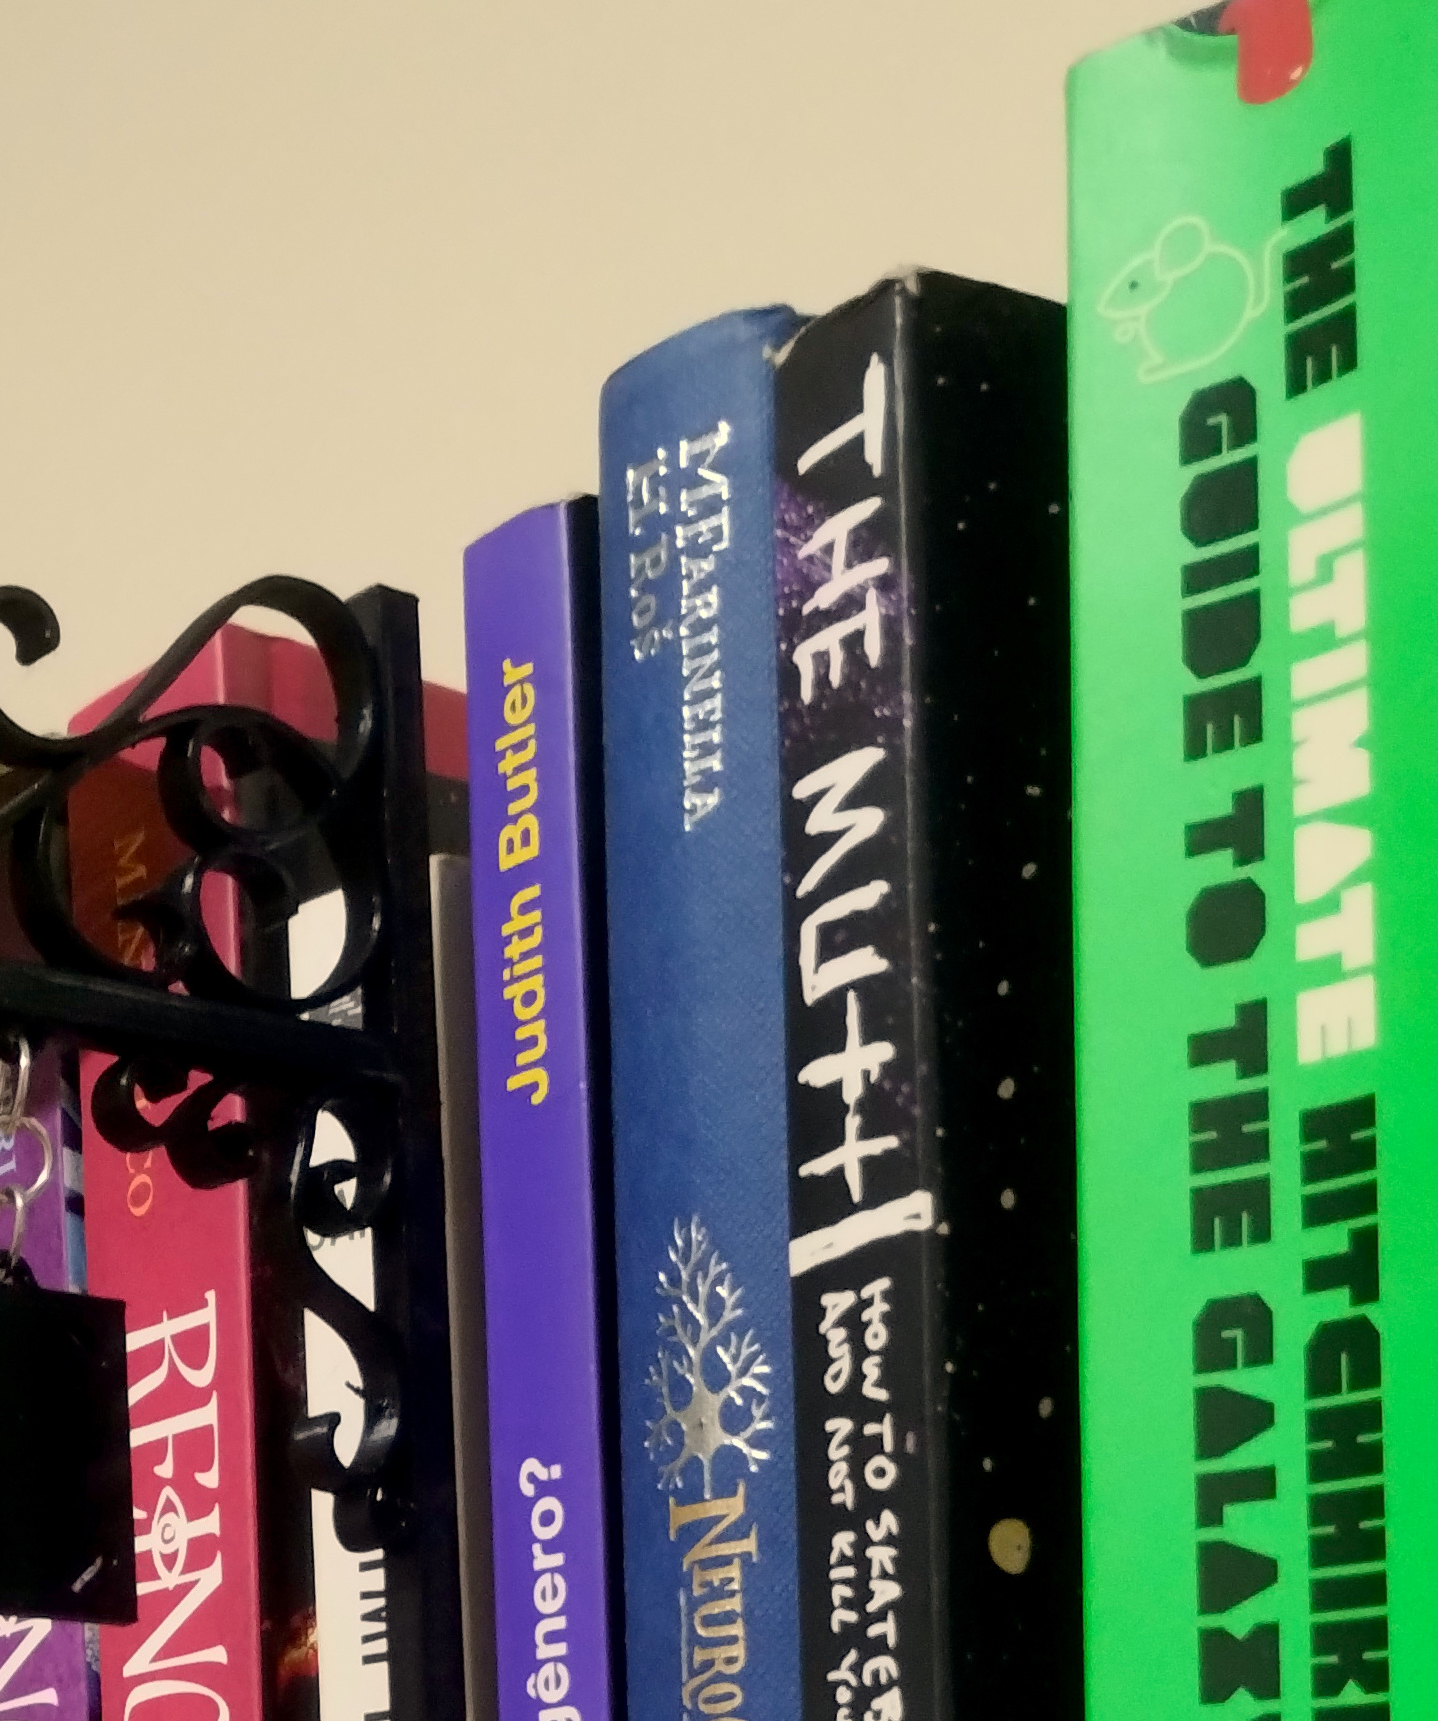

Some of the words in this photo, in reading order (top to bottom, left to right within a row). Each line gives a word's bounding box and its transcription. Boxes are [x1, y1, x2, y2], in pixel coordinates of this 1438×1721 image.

[1281, 132, 1358, 400] THE
[792, 352, 891, 705] THE
[1179, 375, 1263, 763] GUIDE
[495, 657, 543, 873] Butler
[1286, 410, 1377, 1066] ULTIMATE
[1184, 784, 1268, 971] TO
[501, 882, 549, 1106] Judith
[1187, 997, 1273, 1255] THE
[818, 1289, 857, 1396] AND
[860, 1276, 893, 1401] HOW
[824, 1418, 857, 1511] NOT
[863, 1410, 897, 1490] TO
[826, 1530, 860, 1634] KILL
